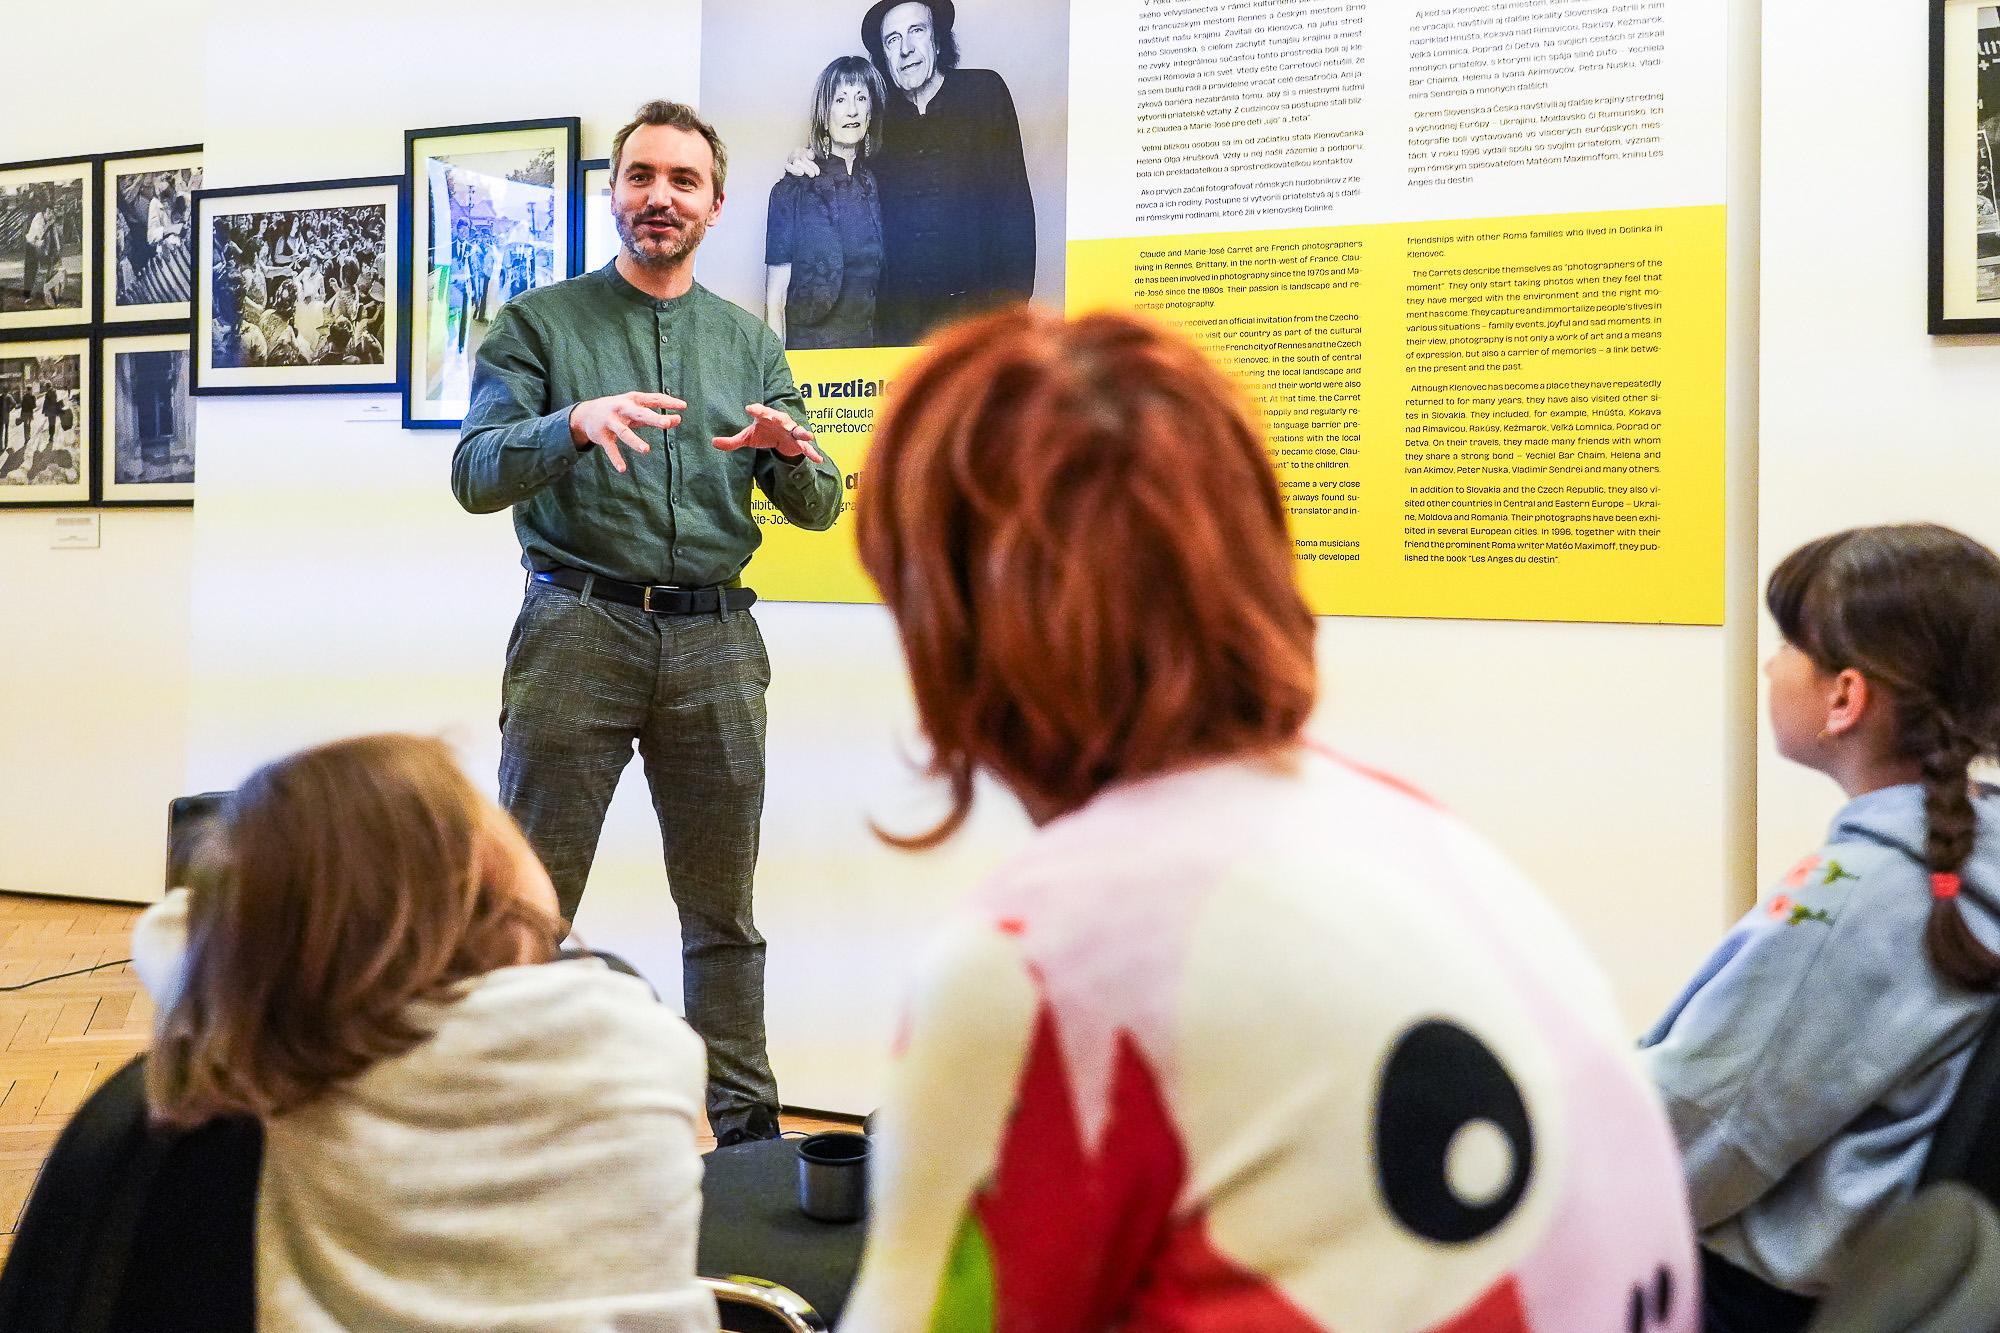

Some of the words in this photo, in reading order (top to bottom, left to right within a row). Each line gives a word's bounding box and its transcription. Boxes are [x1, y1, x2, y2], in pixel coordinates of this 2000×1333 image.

[1407, 232, 1454, 246] friendships
[1456, 232, 1474, 241] with
[1476, 230, 1500, 240] other
[1502, 229, 1527, 239] Roma
[1529, 227, 1563, 238] families
[1565, 226, 1583, 236] who
[1586, 226, 1606, 235] lived
[1608, 225, 1616, 234] in
[1619, 223, 1651, 234] Dolinka
[1654, 223, 1662, 232] in
[1139, 248, 1165, 257] Claude
[1167, 247, 1182, 256] and
[1184, 245, 1224, 255] Marie-José
[1226, 244, 1252, 253] Carret
[1271, 242, 1299, 251] French
[1301, 239, 1362, 252] photographers
[1134, 261, 1153, 272] living
[1155, 261, 1162, 269] in
[1230, 258, 1237, 266] in
[1239, 257, 1252, 266] the
[1254, 255, 1297, 265] north-west
[1299, 255, 1307, 263] of
[1406, 294, 1424, 306] they
[1427, 294, 1446, 303] have
[1449, 292, 1482, 305] merged
[1485, 292, 1503, 301] with
[1506, 291, 1520, 301] the
[1523, 289, 1579, 300] environment
[1582, 289, 1598, 298] and
[1601, 288, 1616, 298] the
[1619, 287, 1641, 299] right
[1205, 329, 1220, 338] visit
[1239, 328, 1270, 339] country
[1284, 327, 1301, 338] part
[1303, 327, 1312, 335] of
[1314, 326, 1327, 335] the
[1329, 325, 1361, 334] cultural
[1418, 363, 1431, 372] the
[1433, 362, 1466, 374] present
[1468, 362, 1484, 371] and
[1486, 361, 1500, 371] the
[800, 383, 812, 398] a
[818, 379, 885, 398] vzdial
[836, 408, 874, 419] Clauda
[1405, 410, 1418, 419] tes
[1421, 410, 1428, 419] in
[1471, 409, 1490, 420] They
[1534, 408, 1547, 417] for
[1628, 406, 1661, 416] Kokava
[810, 422, 874, 433] Carretovco
[1432, 437, 1444, 446] On
[1446, 436, 1467, 446] their
[1503, 436, 1522, 448] they
[1524, 436, 1548, 445] made
[1551, 438, 1575, 447] many
[1577, 435, 1609, 445] friends
[1611, 435, 1631, 444] with
[1633, 435, 1661, 444] whom
[1290, 460, 1299, 468] to
[1300, 460, 1314, 468] the
[1278, 479, 1310, 487] became
[1319, 482, 1337, 490] very
[1338, 479, 1360, 487] close
[1410, 484, 1417, 493] In
[1419, 484, 1453, 493] addition
[1455, 484, 1464, 493] to
[1466, 484, 1500, 493] Slovakia
[1502, 484, 1519, 493] and
[1521, 484, 1535, 493] the
[1537, 484, 1564, 493] Czech
[1608, 484, 1627, 495] they
[1629, 484, 1647, 493] also
[1404, 526, 1425, 535] bited
[1427, 526, 1435, 535] in
[1437, 526, 1468, 535] several
[1470, 526, 1511, 537] European
[1541, 526, 1549, 535] In
[1575, 526, 1614, 537] together
[1616, 526, 1635, 535] with
[1638, 526, 1660, 535] their
[1296, 538, 1318, 546] Roma
[1319, 538, 1359, 546] musicians
[1404, 539, 1429, 548] friend
[1430, 539, 1444, 548] the
[1445, 539, 1490, 551] prominent
[1491, 539, 1515, 549] Roma
[1516, 540, 1544, 549] writer
[1545, 540, 1573, 549] Matéo
[1619, 540, 1638, 552] they
[1318, 552, 1359, 562] developed
[1404, 552, 1428, 562] lished
[1430, 553, 1444, 562] the
[1446, 553, 1466, 562] book
[1487, 553, 1513, 565] Anges
[1514, 553, 1526, 562] du
